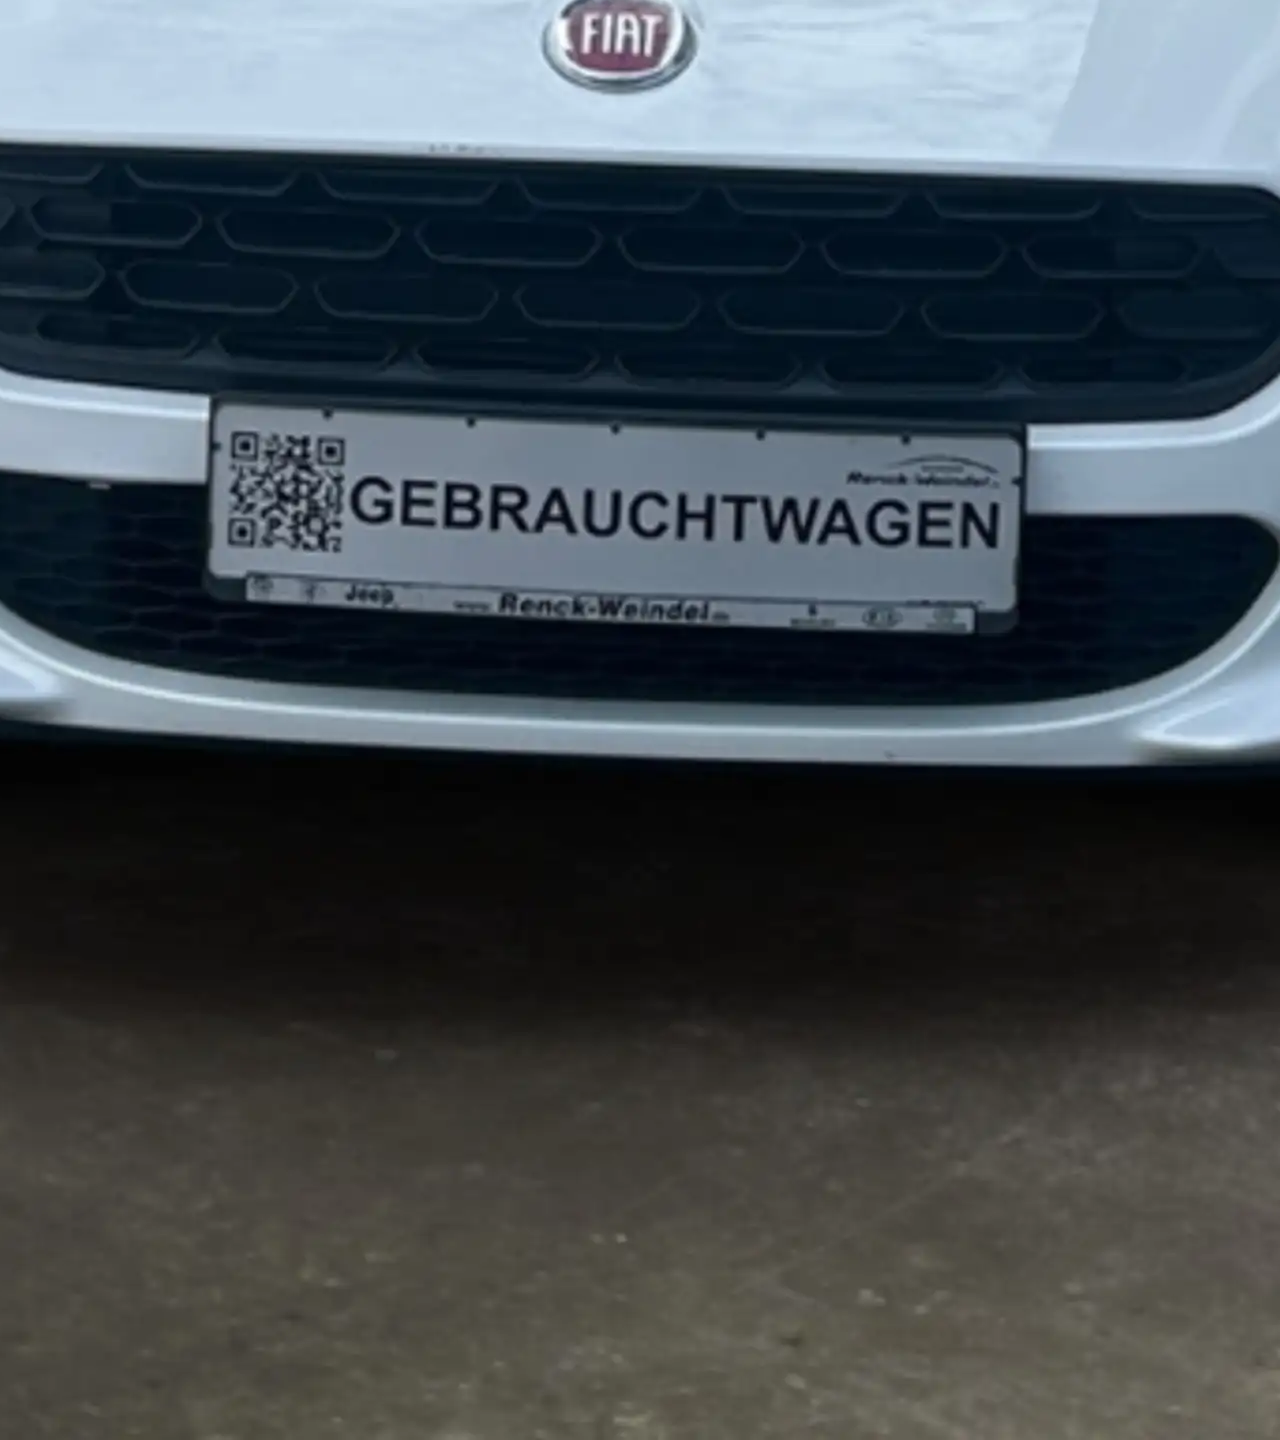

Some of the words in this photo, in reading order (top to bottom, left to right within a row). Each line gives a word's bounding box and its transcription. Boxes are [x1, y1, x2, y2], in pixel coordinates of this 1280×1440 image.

[582, 12, 664, 57] FIAT
[349, 475, 1001, 550] GEBRAUCHTWAGEN
[345, 583, 395, 607] Jeep
